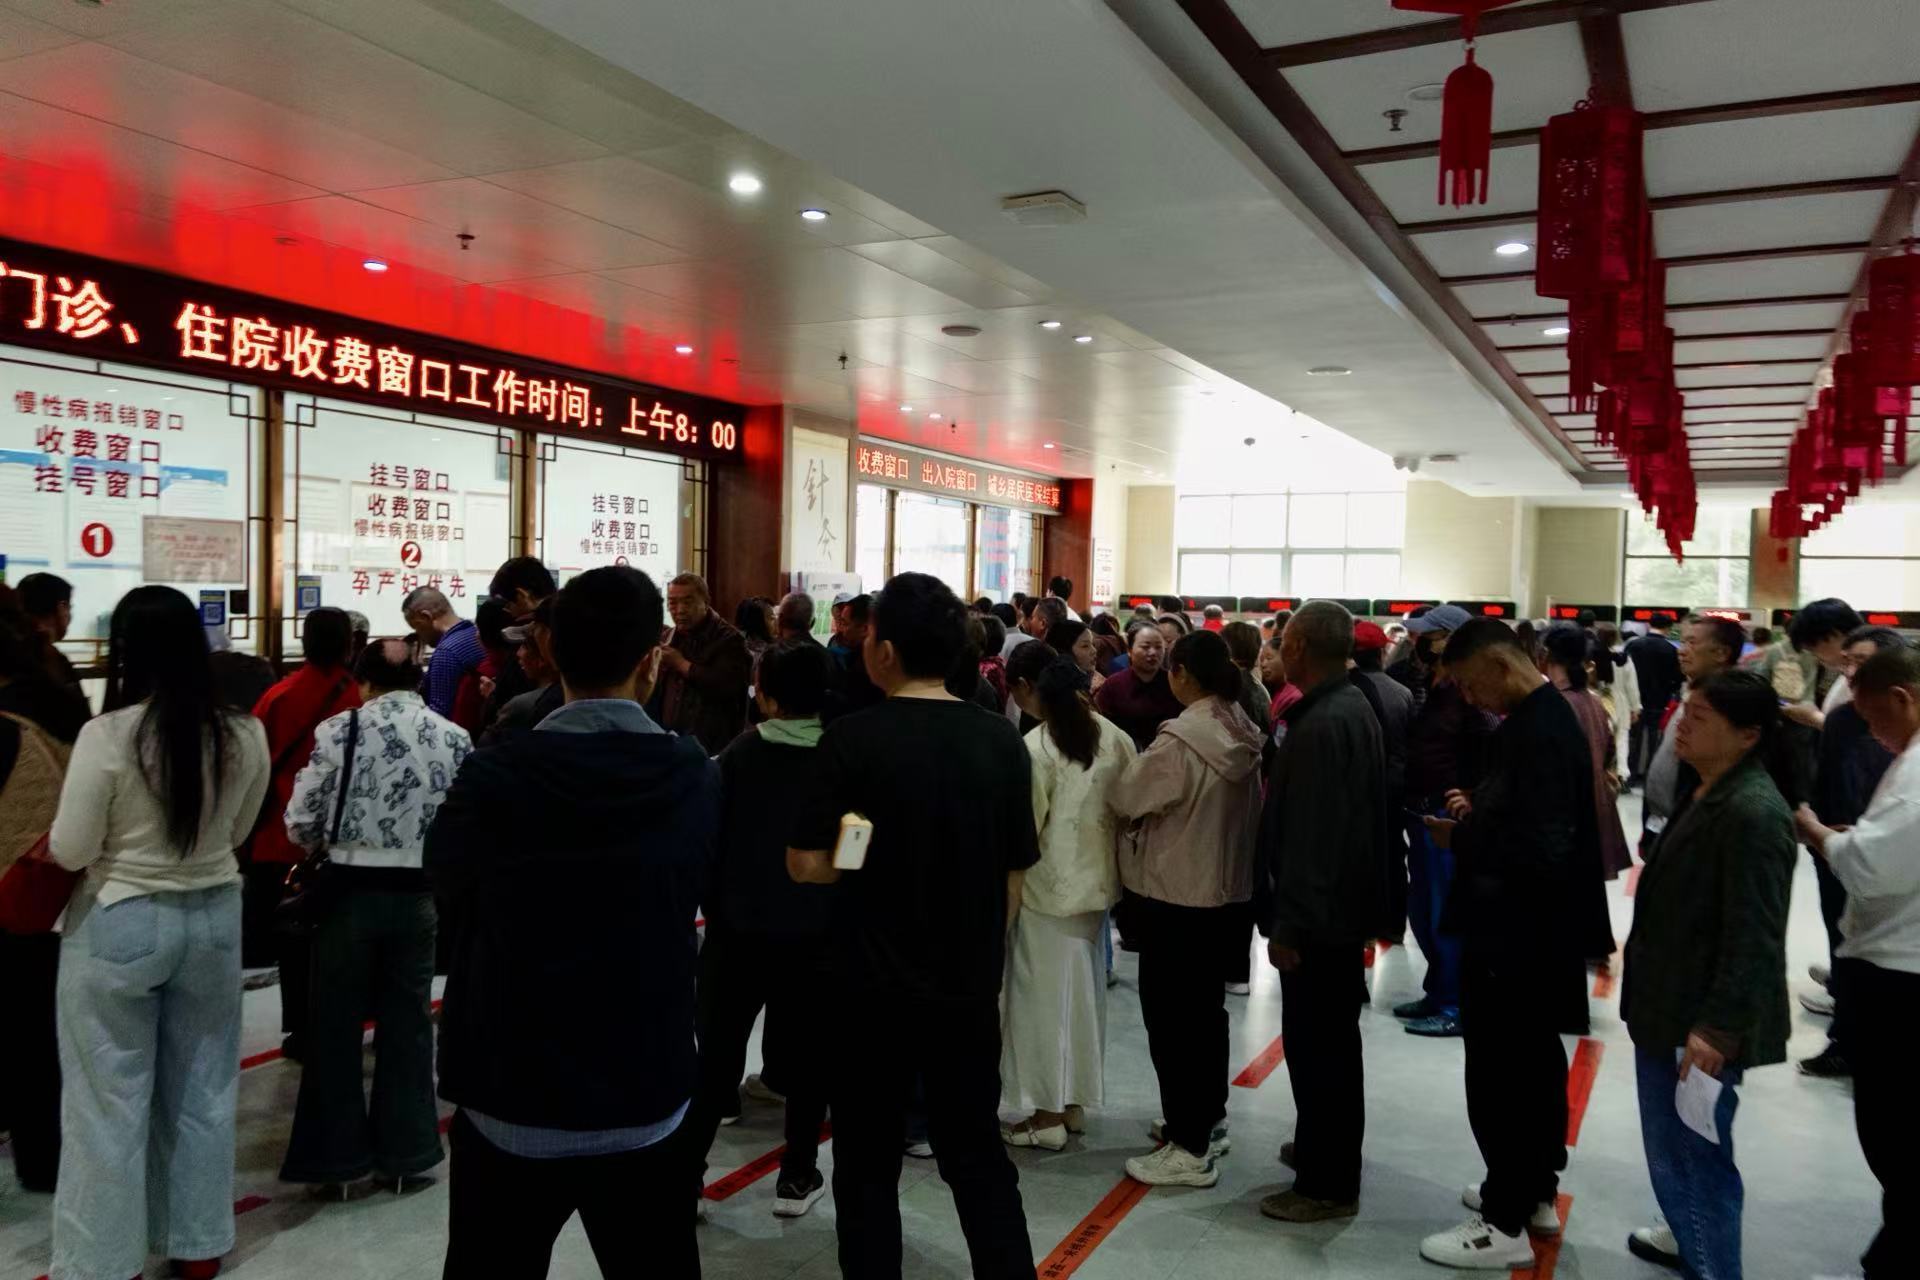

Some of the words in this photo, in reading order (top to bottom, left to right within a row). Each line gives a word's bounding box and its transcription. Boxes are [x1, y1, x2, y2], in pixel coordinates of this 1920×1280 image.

[13, 390, 185, 431] 慢性病报销窗口
[35, 424, 161, 463] 收费窗口
[370, 462, 449, 491] 挂号窗口
[857, 447, 909, 480] 收费窗口
[922, 461, 977, 491] 出入院窗口
[33, 463, 160, 498] 挂号窗口
[368, 493, 450, 521] 收费窗口
[592, 493, 648, 514] 挂号窗口
[86, 525, 110, 556] 1
[354, 518, 464, 541] 慢性病报销窗口
[592, 519, 650, 540] 收费窗口
[402, 543, 420, 567] 2
[580, 538, 658, 556] 慢性病报销窗口
